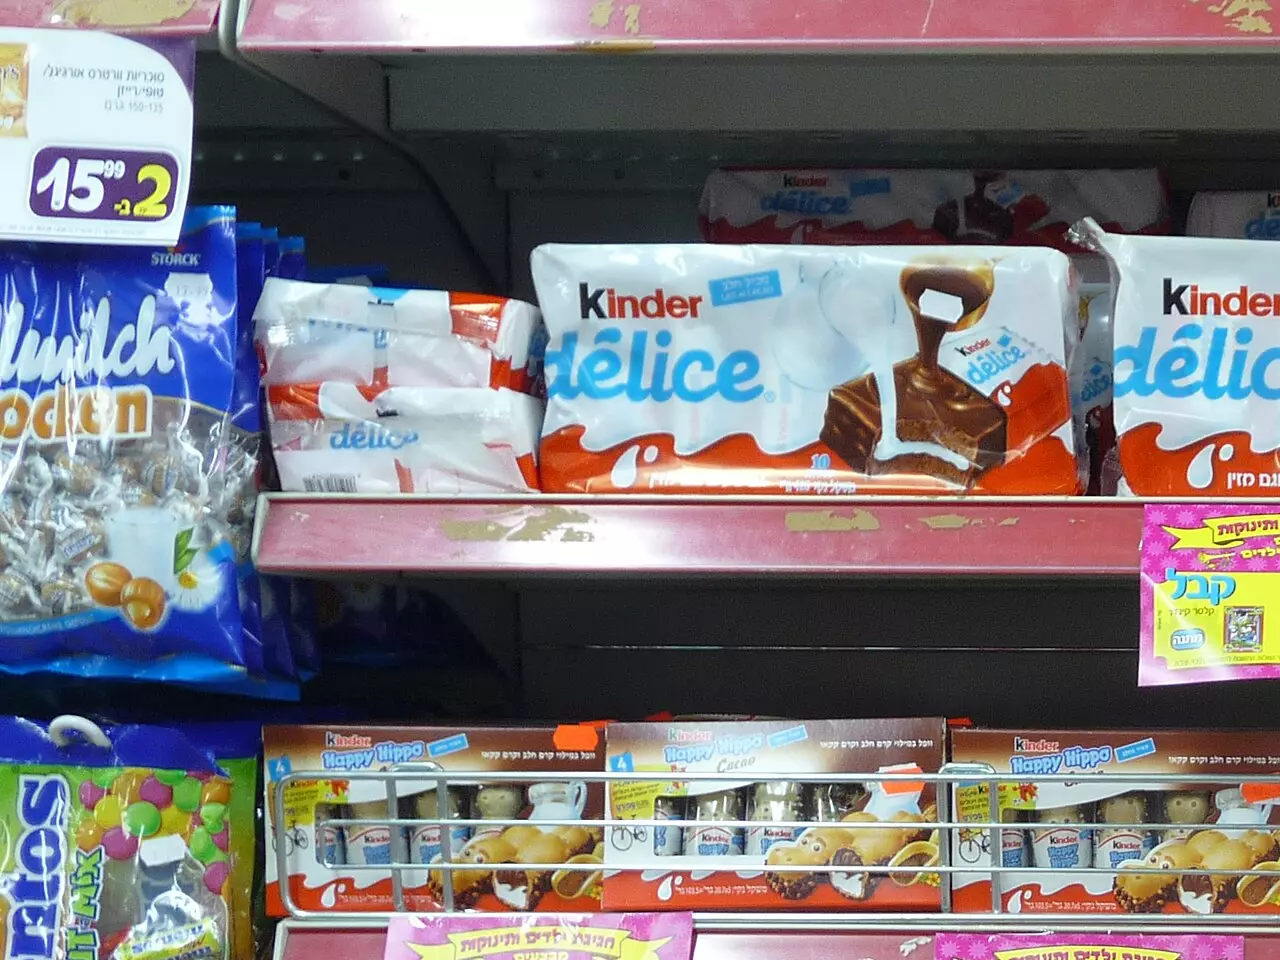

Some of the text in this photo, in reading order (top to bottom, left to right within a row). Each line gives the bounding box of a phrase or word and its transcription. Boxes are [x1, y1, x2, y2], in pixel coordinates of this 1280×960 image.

[151, 252, 200, 266] STORCK
[580, 282, 702, 320] Kinder
[546, 327, 764, 403] délice
[1227, 472, 1255, 489] מזין
[1165, 568, 1236, 606] קבל
[325, 732, 372, 747] Kinder
[1014, 737, 1059, 751] Kinder
[321, 741, 424, 769] Happy Hippo
[1010, 747, 1112, 774] Happy Hippo
[717, 757, 756, 773] Cacao
[1050, 836, 1077, 844] Kinder
[1113, 841, 1140, 849] Kinder
